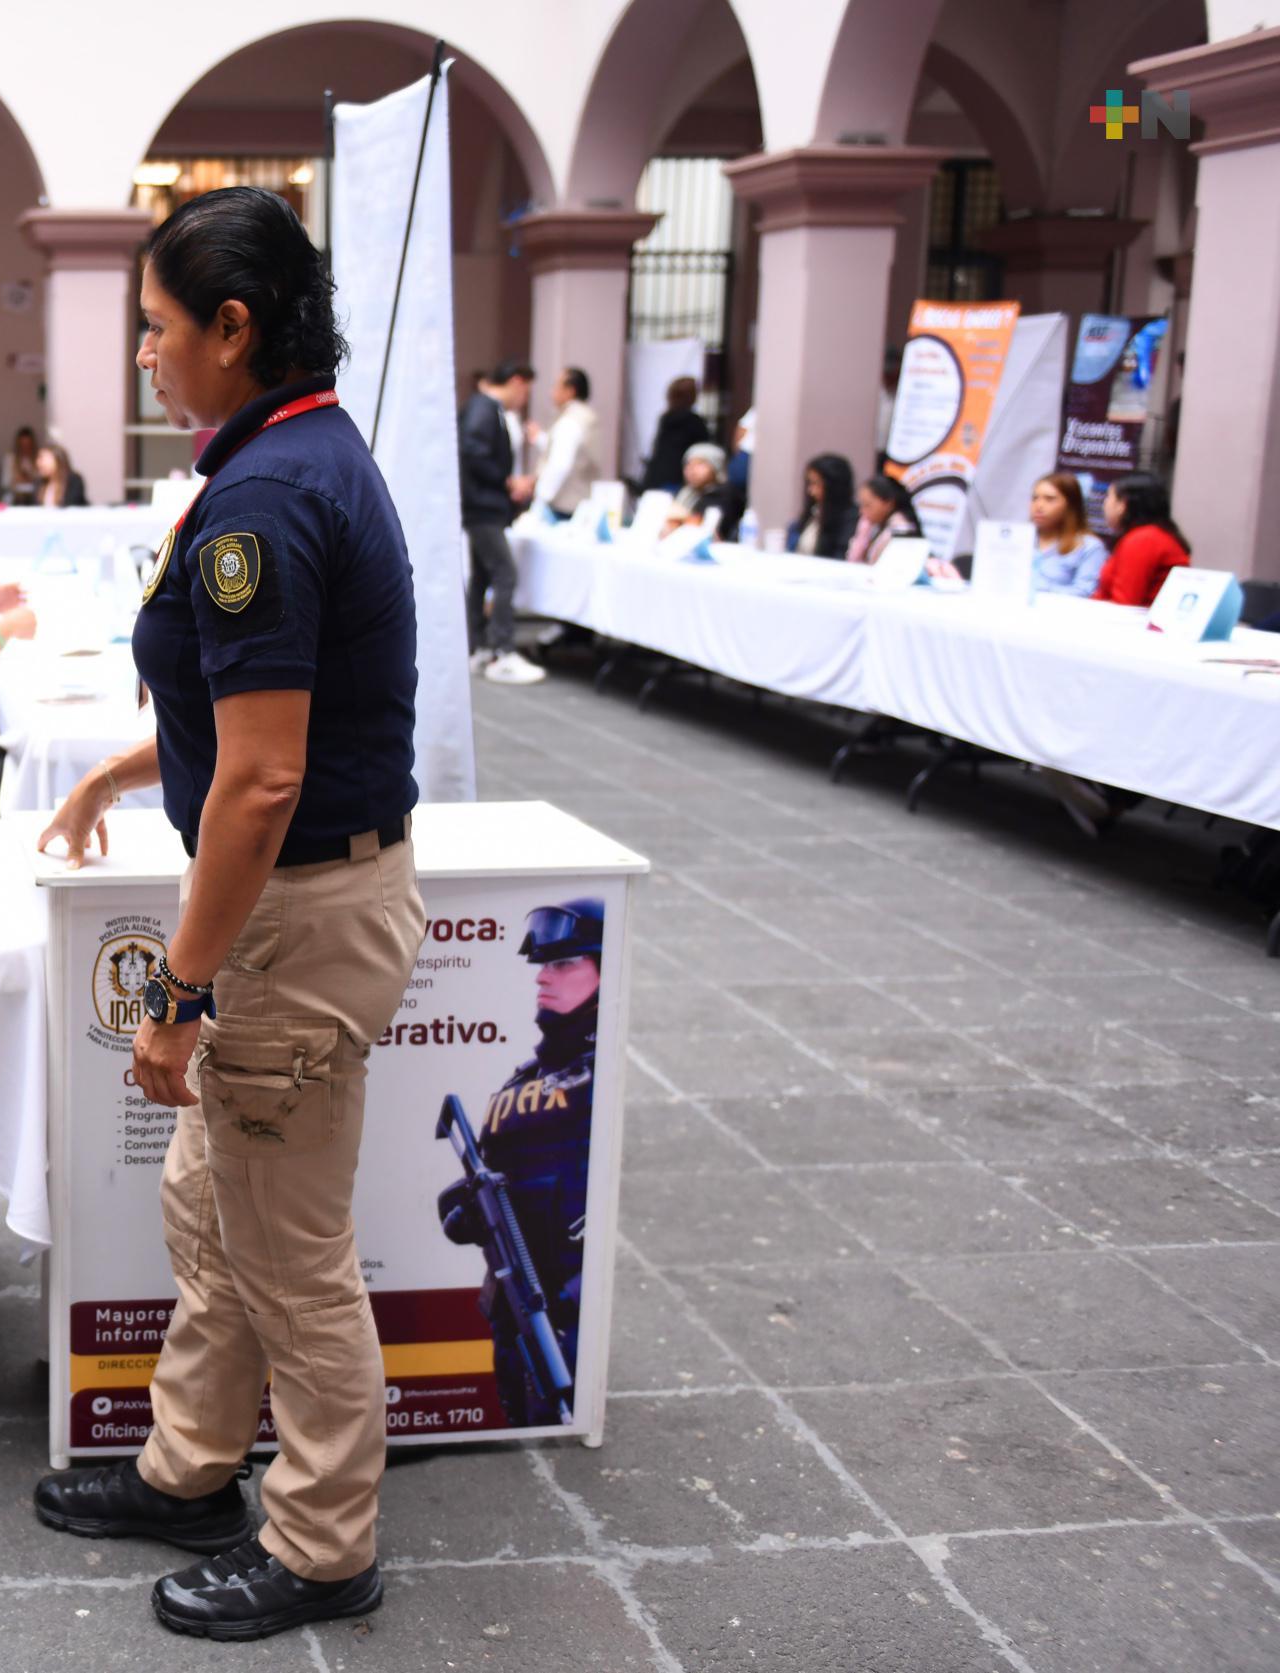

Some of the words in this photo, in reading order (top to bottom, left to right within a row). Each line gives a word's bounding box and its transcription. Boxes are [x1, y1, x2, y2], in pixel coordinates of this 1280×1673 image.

[105, 916, 140, 928] INSTITUTO
[152, 918, 161, 927] LA
[99, 922, 130, 942] POLICÍA
[131, 924, 167, 941] AUXILIAR
[416, 955, 471, 972] espíritu
[110, 1000, 144, 1034] IPA
[86, 1032, 102, 1046] PARA
[111, 1044, 134, 1053] ESTAD
[124, 1125, 165, 1137] Seguro
[98, 1357, 159, 1370] DIRECCIÓ
[413, 1411, 443, 1427] Ext.
[448, 1407, 484, 1424] 1710
